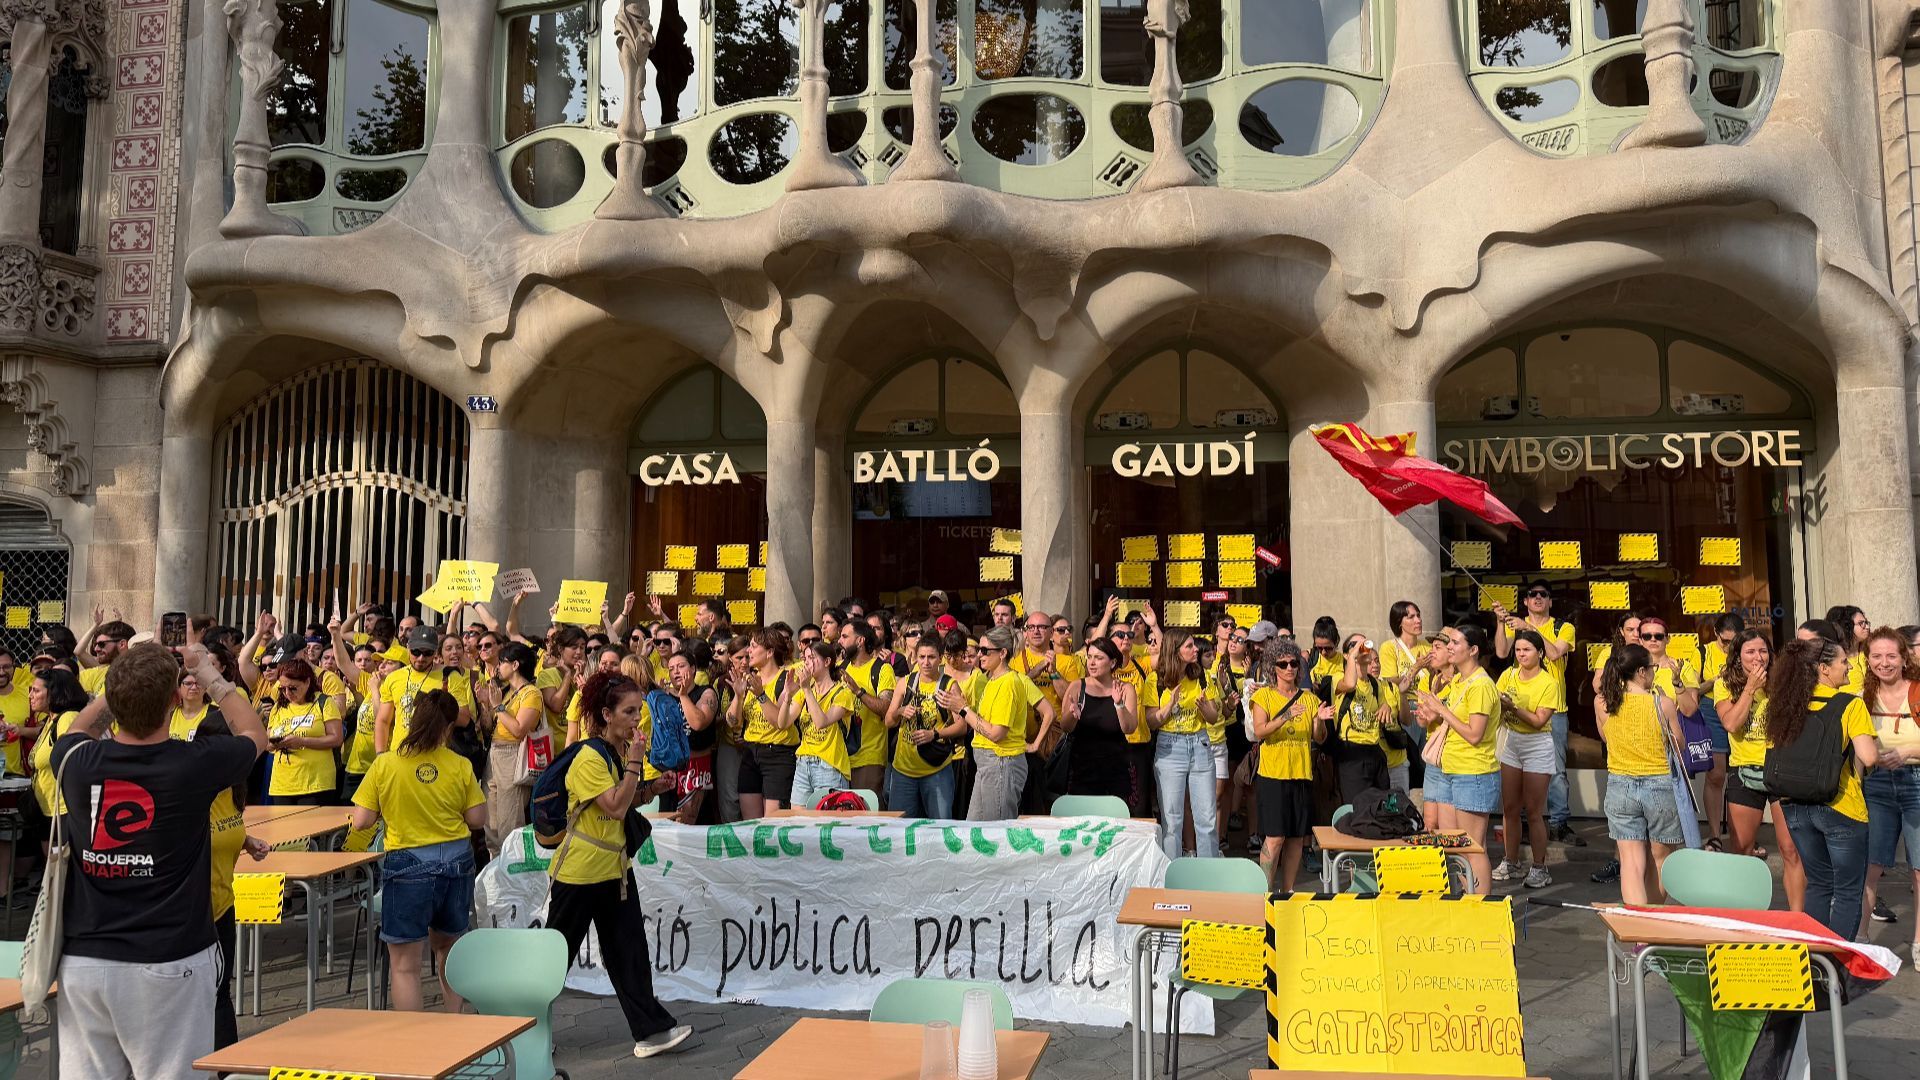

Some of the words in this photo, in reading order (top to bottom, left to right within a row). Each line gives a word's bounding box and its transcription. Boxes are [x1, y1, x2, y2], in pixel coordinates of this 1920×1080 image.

[472, 397, 490, 410] 43
[639, 452, 741, 486] CASA
[853, 438, 1000, 483] BATLLÓ
[1111, 431, 1257, 477] GAUDÍ
[1661, 430, 1802, 469] STORE
[82, 849, 154, 866] ESQUERRA
[82, 861, 154, 878] DIARI.cat
[716, 898, 881, 997] pública
[1302, 903, 1377, 960] RESOL
[1396, 934, 1477, 954] AQUESTA
[1301, 967, 1384, 994] SITUACIÓ
[1286, 1003, 1524, 1056] CATASTRÒFICA
